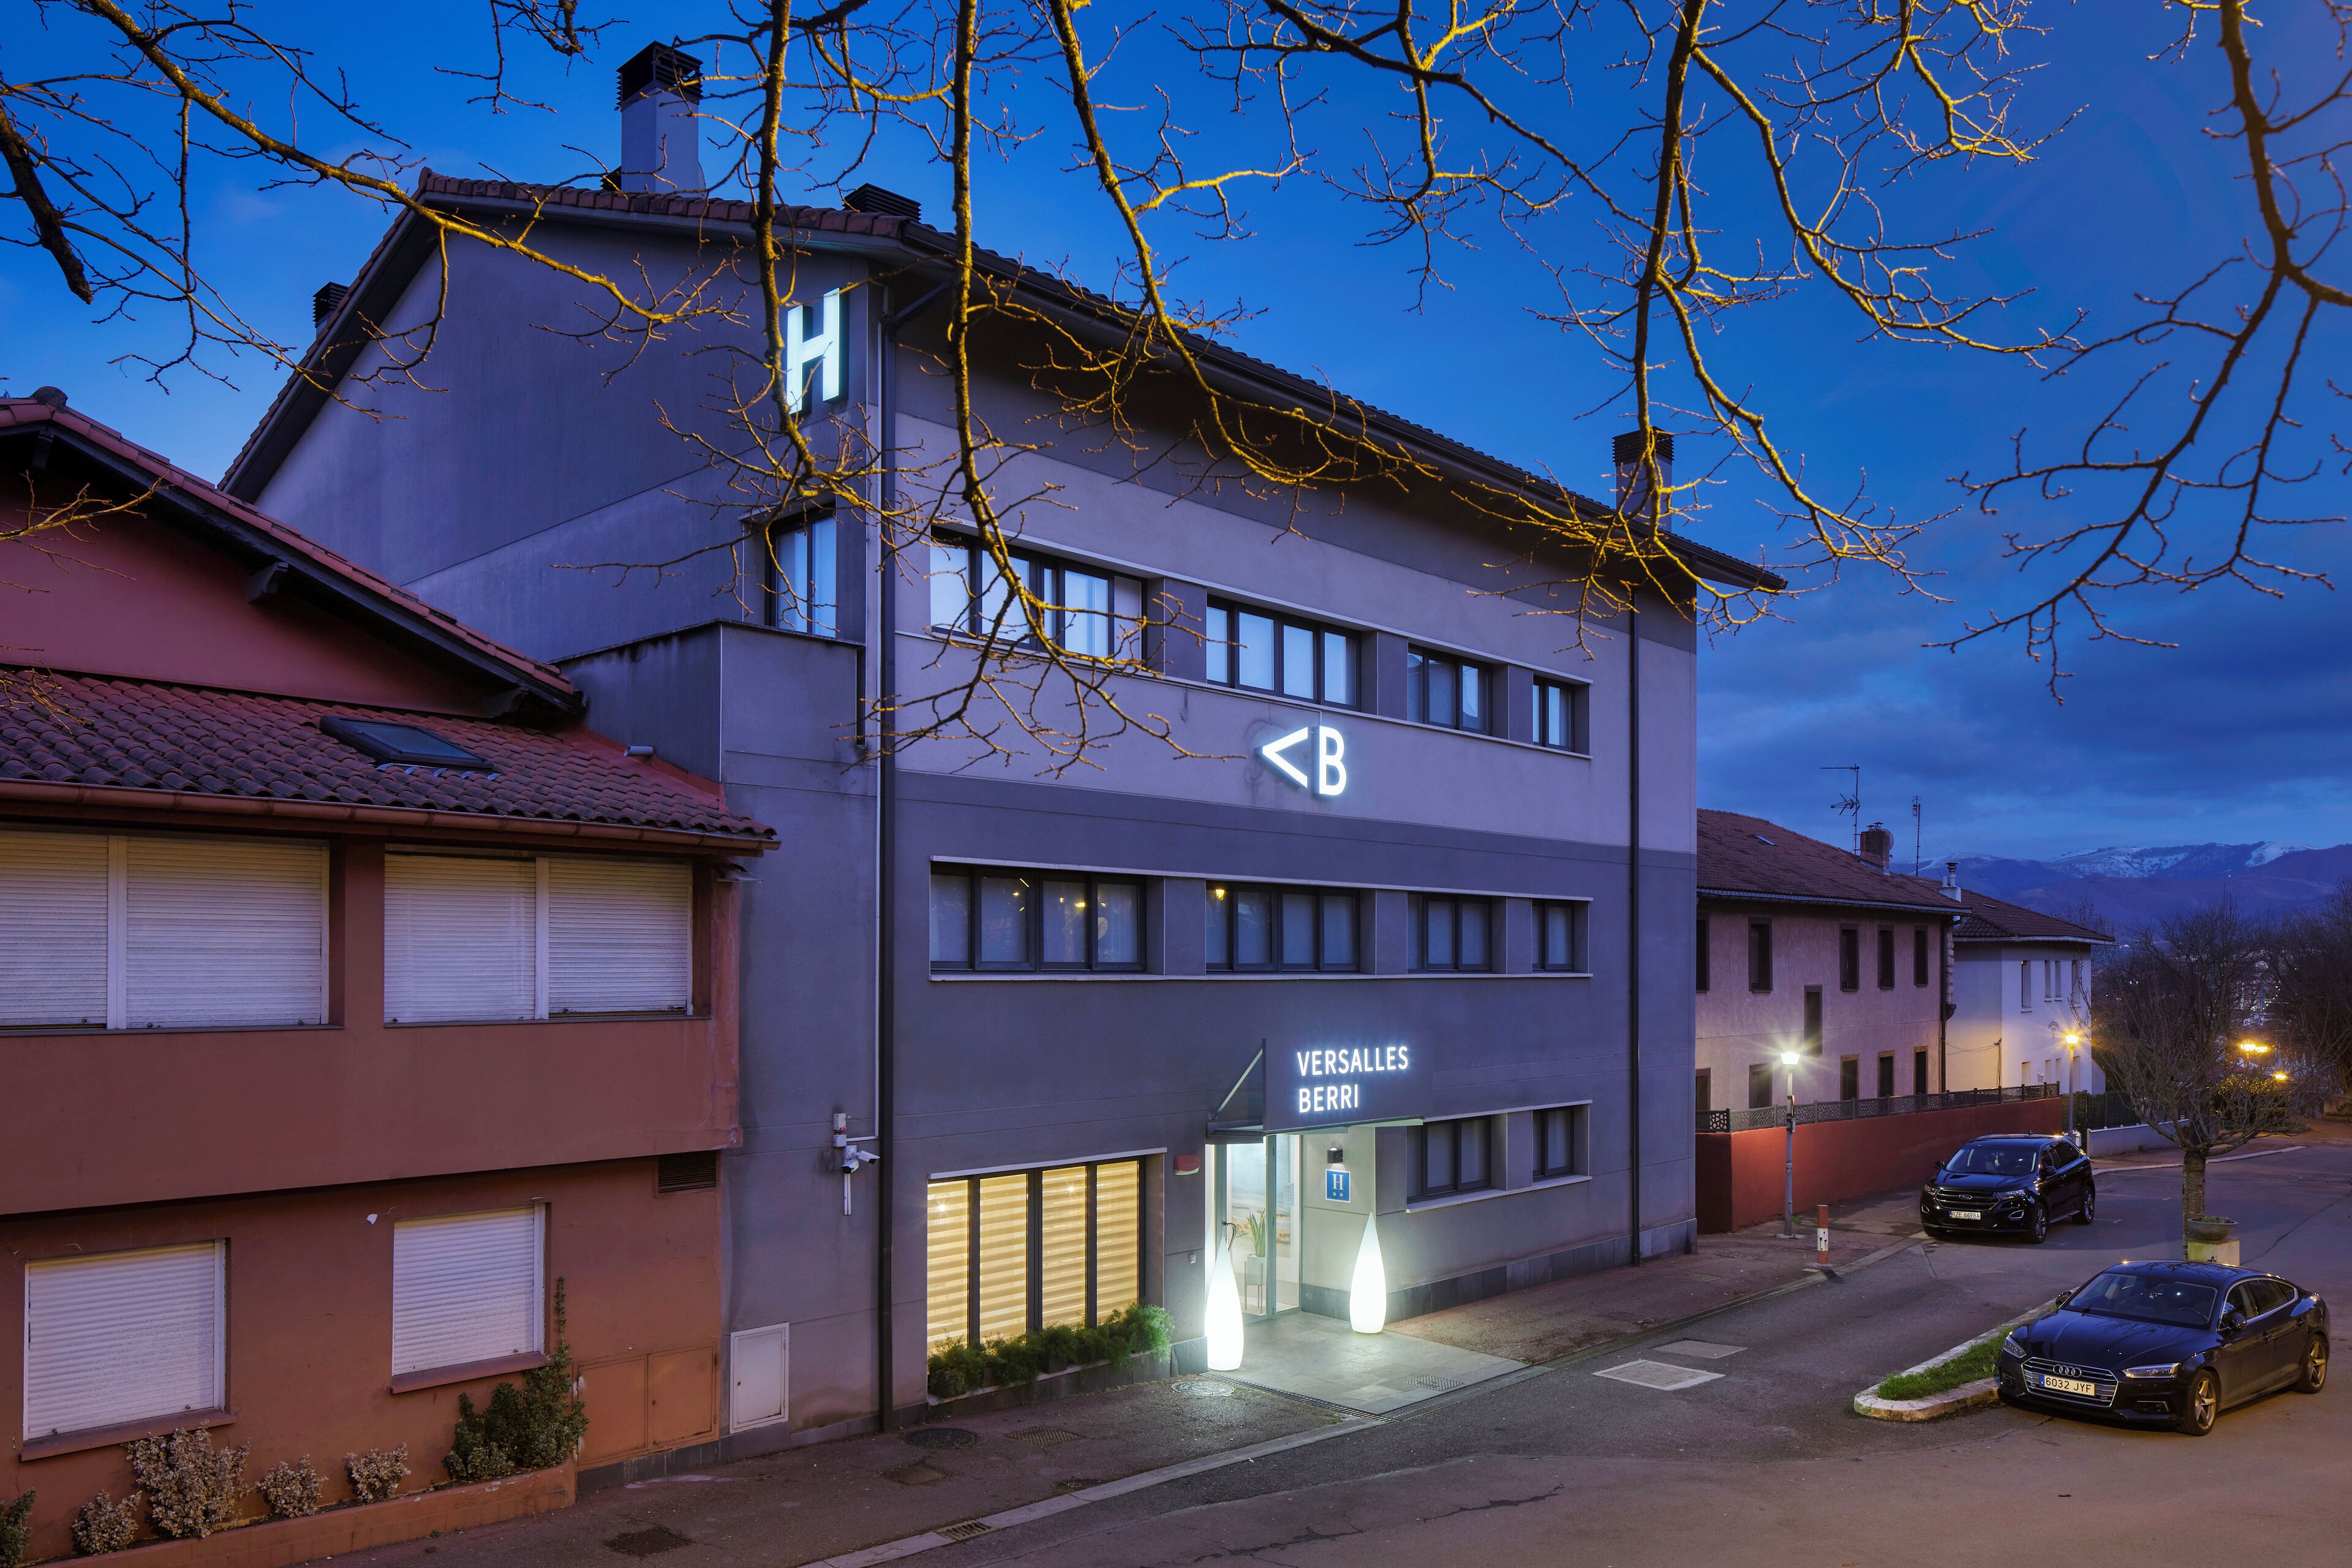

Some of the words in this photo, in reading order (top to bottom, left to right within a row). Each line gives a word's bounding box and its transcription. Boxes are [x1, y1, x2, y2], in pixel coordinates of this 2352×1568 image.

[786, 287, 840, 415] H
[1297, 1046, 1409, 1077] VERSALLES
[1298, 1084, 1359, 1114] BERRI
[1332, 1174, 1344, 1191] H
[2046, 1378, 2069, 1389] 6032
[2074, 1382, 2091, 1392] JYF
